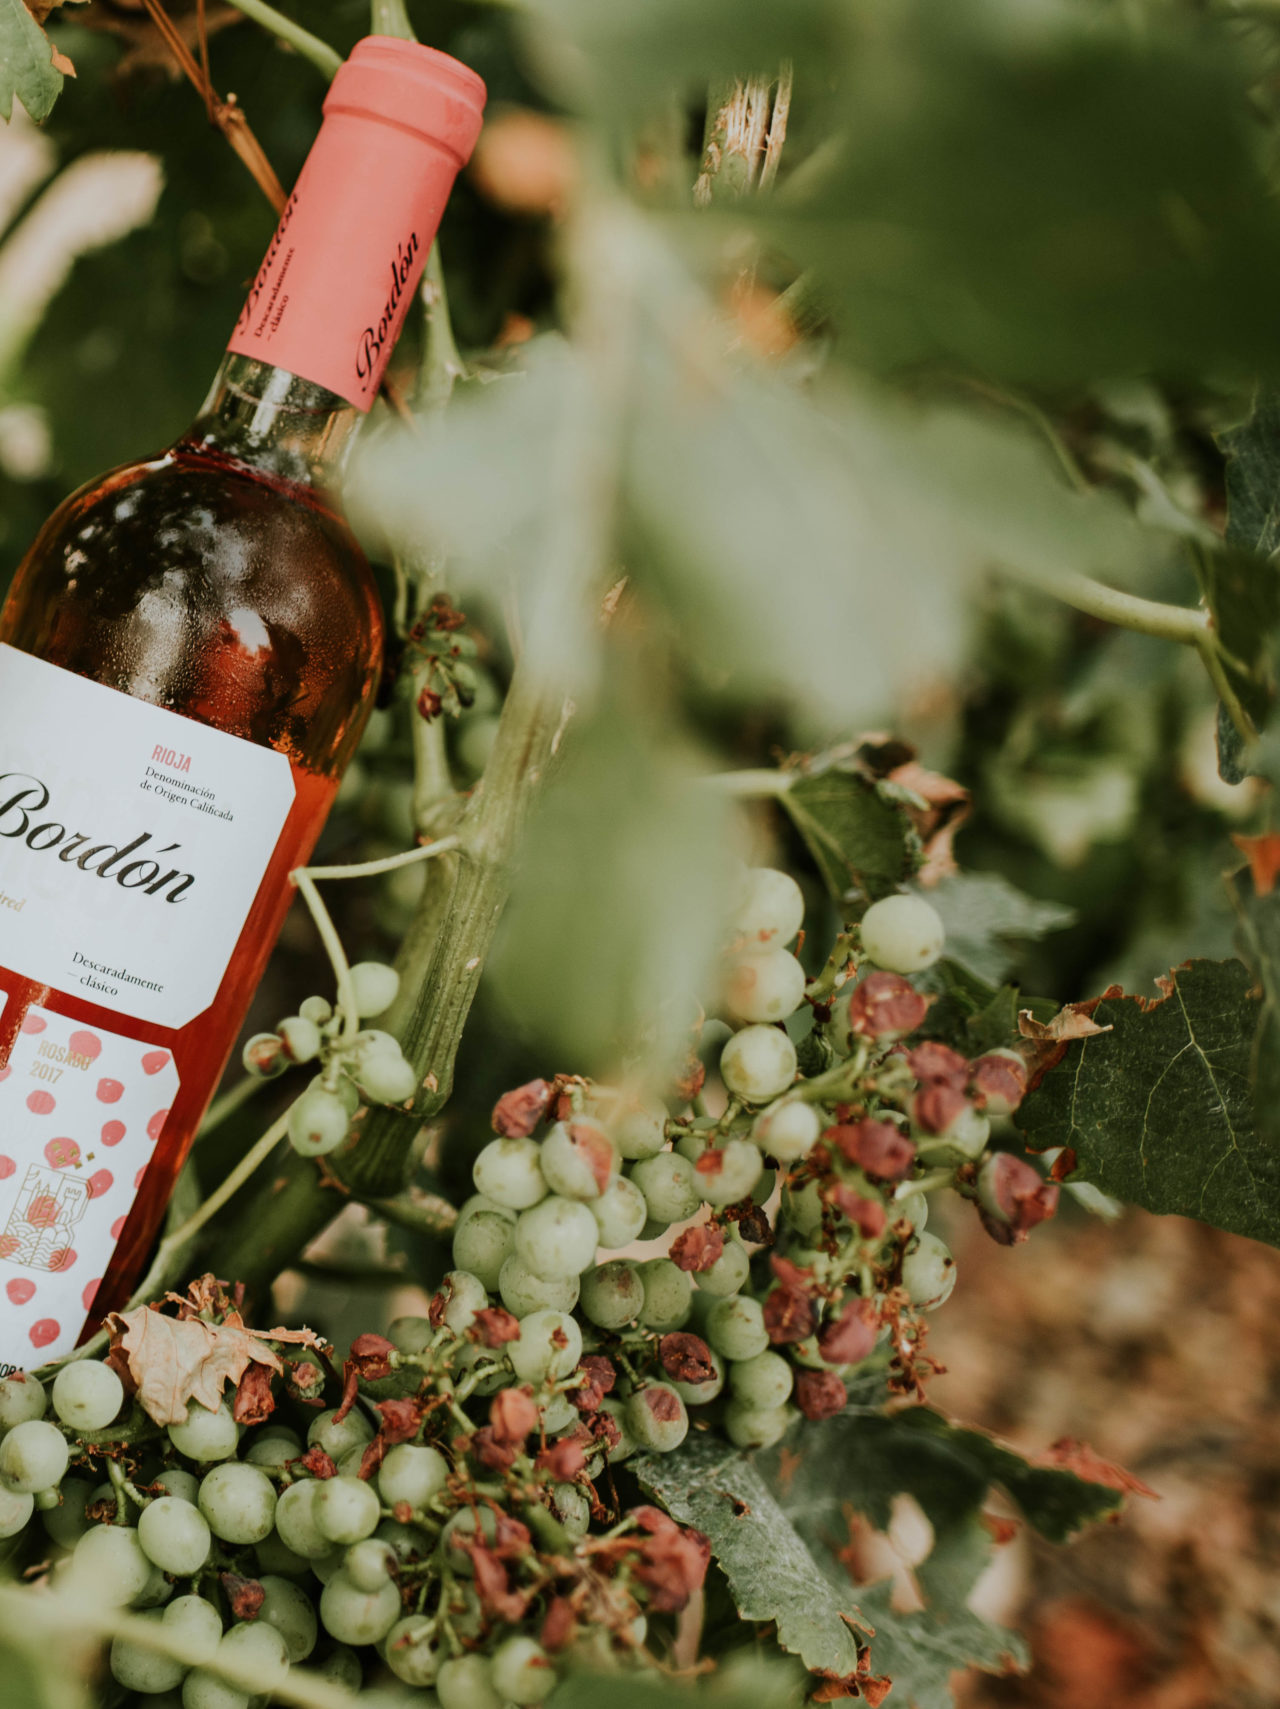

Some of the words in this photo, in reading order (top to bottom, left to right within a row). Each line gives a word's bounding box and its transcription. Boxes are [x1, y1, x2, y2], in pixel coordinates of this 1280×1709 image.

[254, 247, 295, 338] Descaradamente
[270, 295, 289, 332] clásico
[356, 232, 419, 392] Bordón
[151, 744, 192, 773] RIOJA
[145, 766, 216, 800] Denominación
[140, 780, 152, 791] de
[154, 784, 188, 803] Origen
[189, 798, 234, 822] Calificada
[72, 951, 164, 993] Descaradamente
[79, 974, 118, 996] clásico
[29, 1060, 64, 1084] 2017
[37, 1039, 92, 1072] ROSADO
